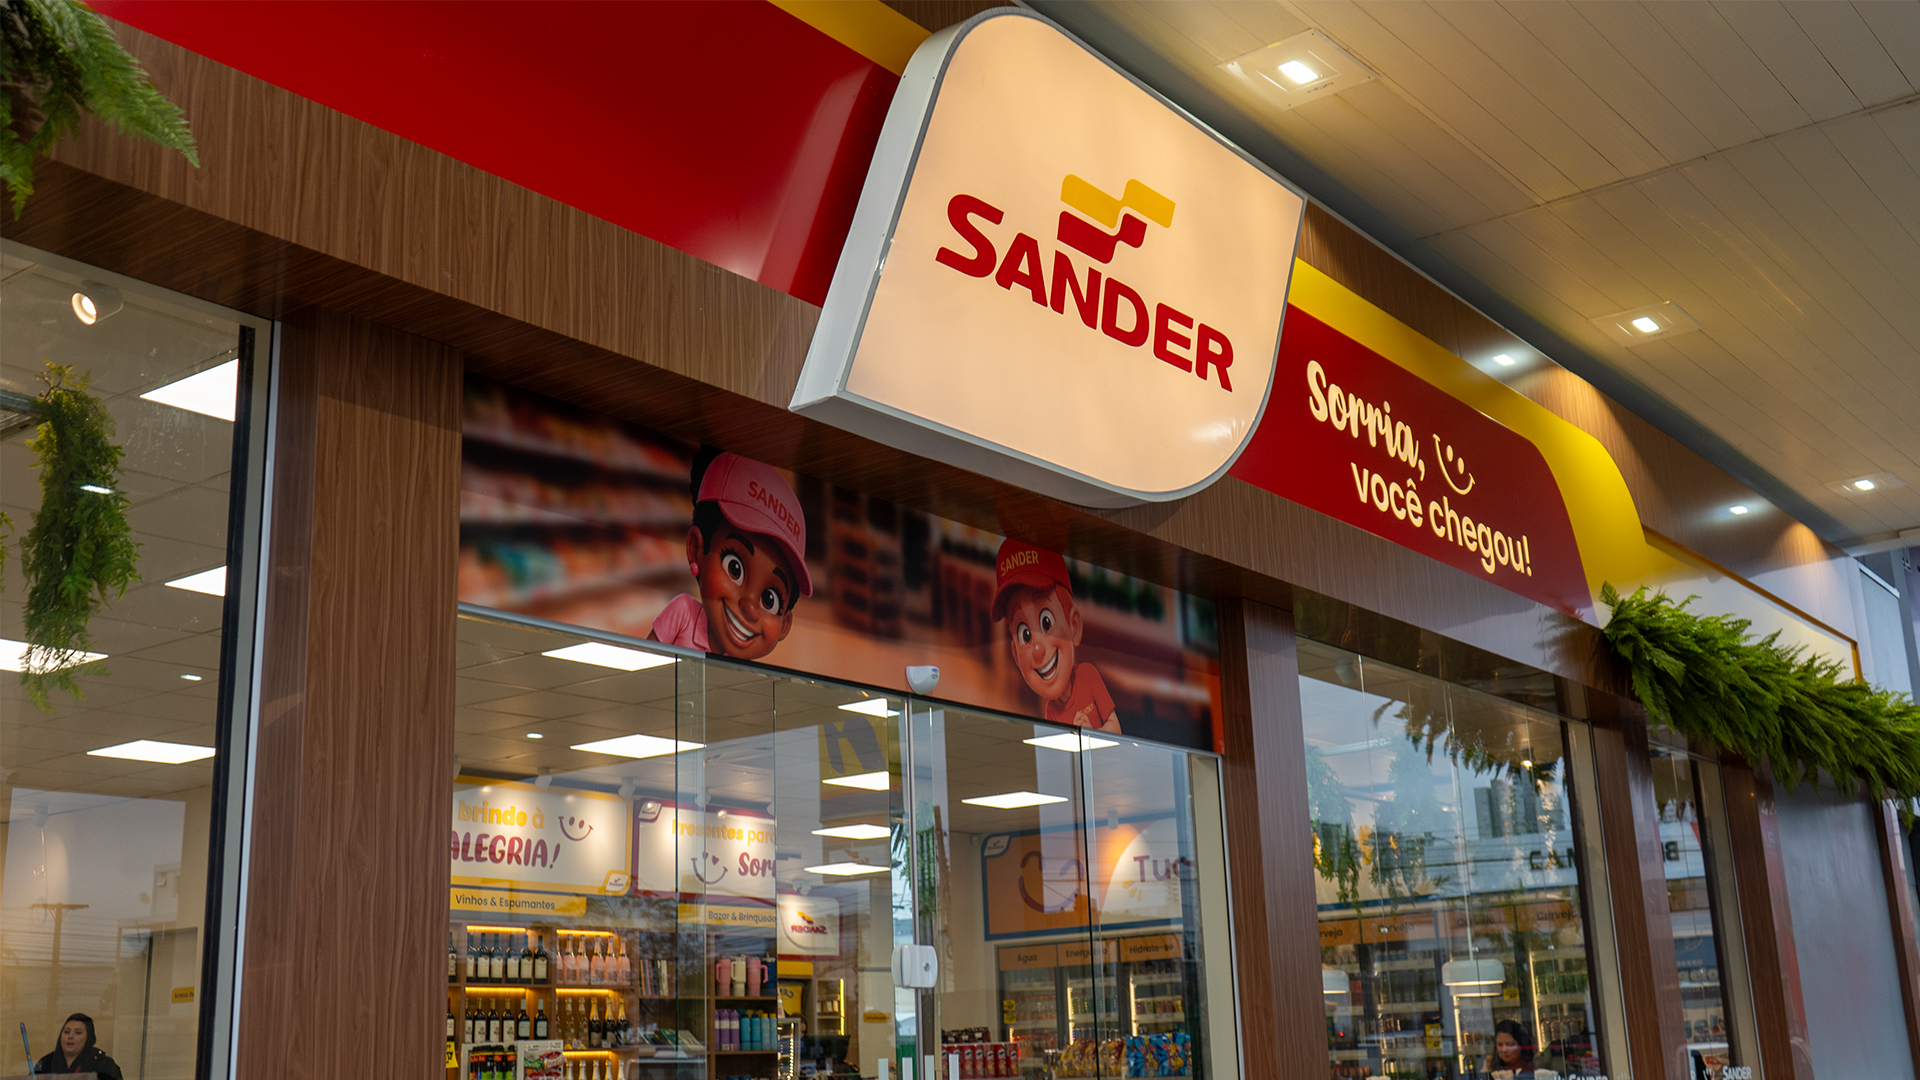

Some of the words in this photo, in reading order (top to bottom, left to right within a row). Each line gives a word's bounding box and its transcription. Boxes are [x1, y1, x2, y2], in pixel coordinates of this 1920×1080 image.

[935, 194, 1234, 393] SANDER
[1307, 360, 1426, 481] Sorria,
[748, 481, 801, 542] SANDER
[1351, 462, 1424, 528] você
[1429, 496, 1532, 577] chegou!
[1000, 550, 1040, 577] SANDER
[458, 800, 528, 827] brinde
[532, 807, 545, 829] à
[455, 894, 488, 906] Vinhos
[490, 897, 498, 907] &
[499, 898, 556, 910] Espumantes
[708, 911, 730, 920] Bazar
[731, 912, 738, 920] &
[1017, 953, 1037, 964] Água
[1722, 1065, 1753, 1080] SANDER
